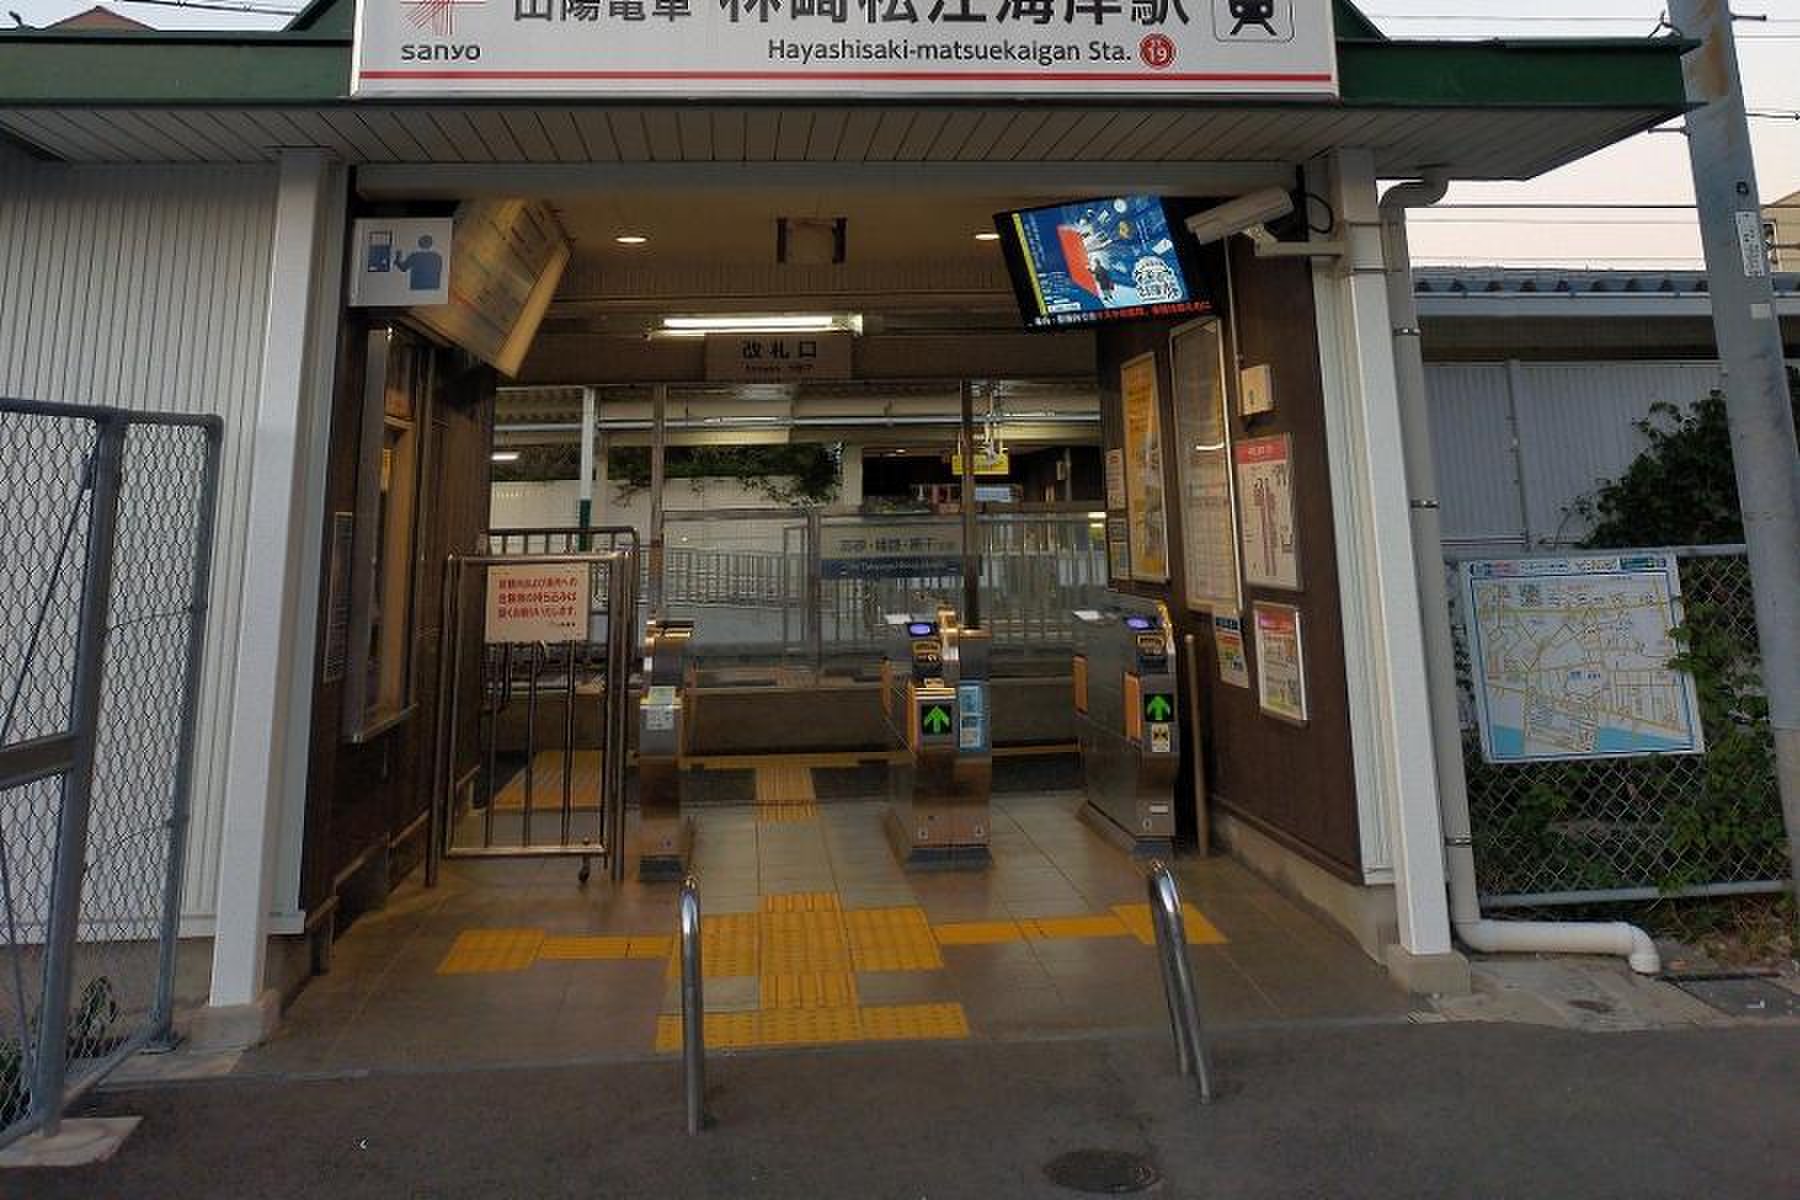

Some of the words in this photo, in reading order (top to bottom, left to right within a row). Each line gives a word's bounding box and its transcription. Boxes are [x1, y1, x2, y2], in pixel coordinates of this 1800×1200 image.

[401, 43, 481, 61] sanyo
[768, 38, 1080, 66] Hayashisaki-matsuekaigan
[1088, 40, 1132, 61] Sta.
[742, 340, 817, 360] 改札口
